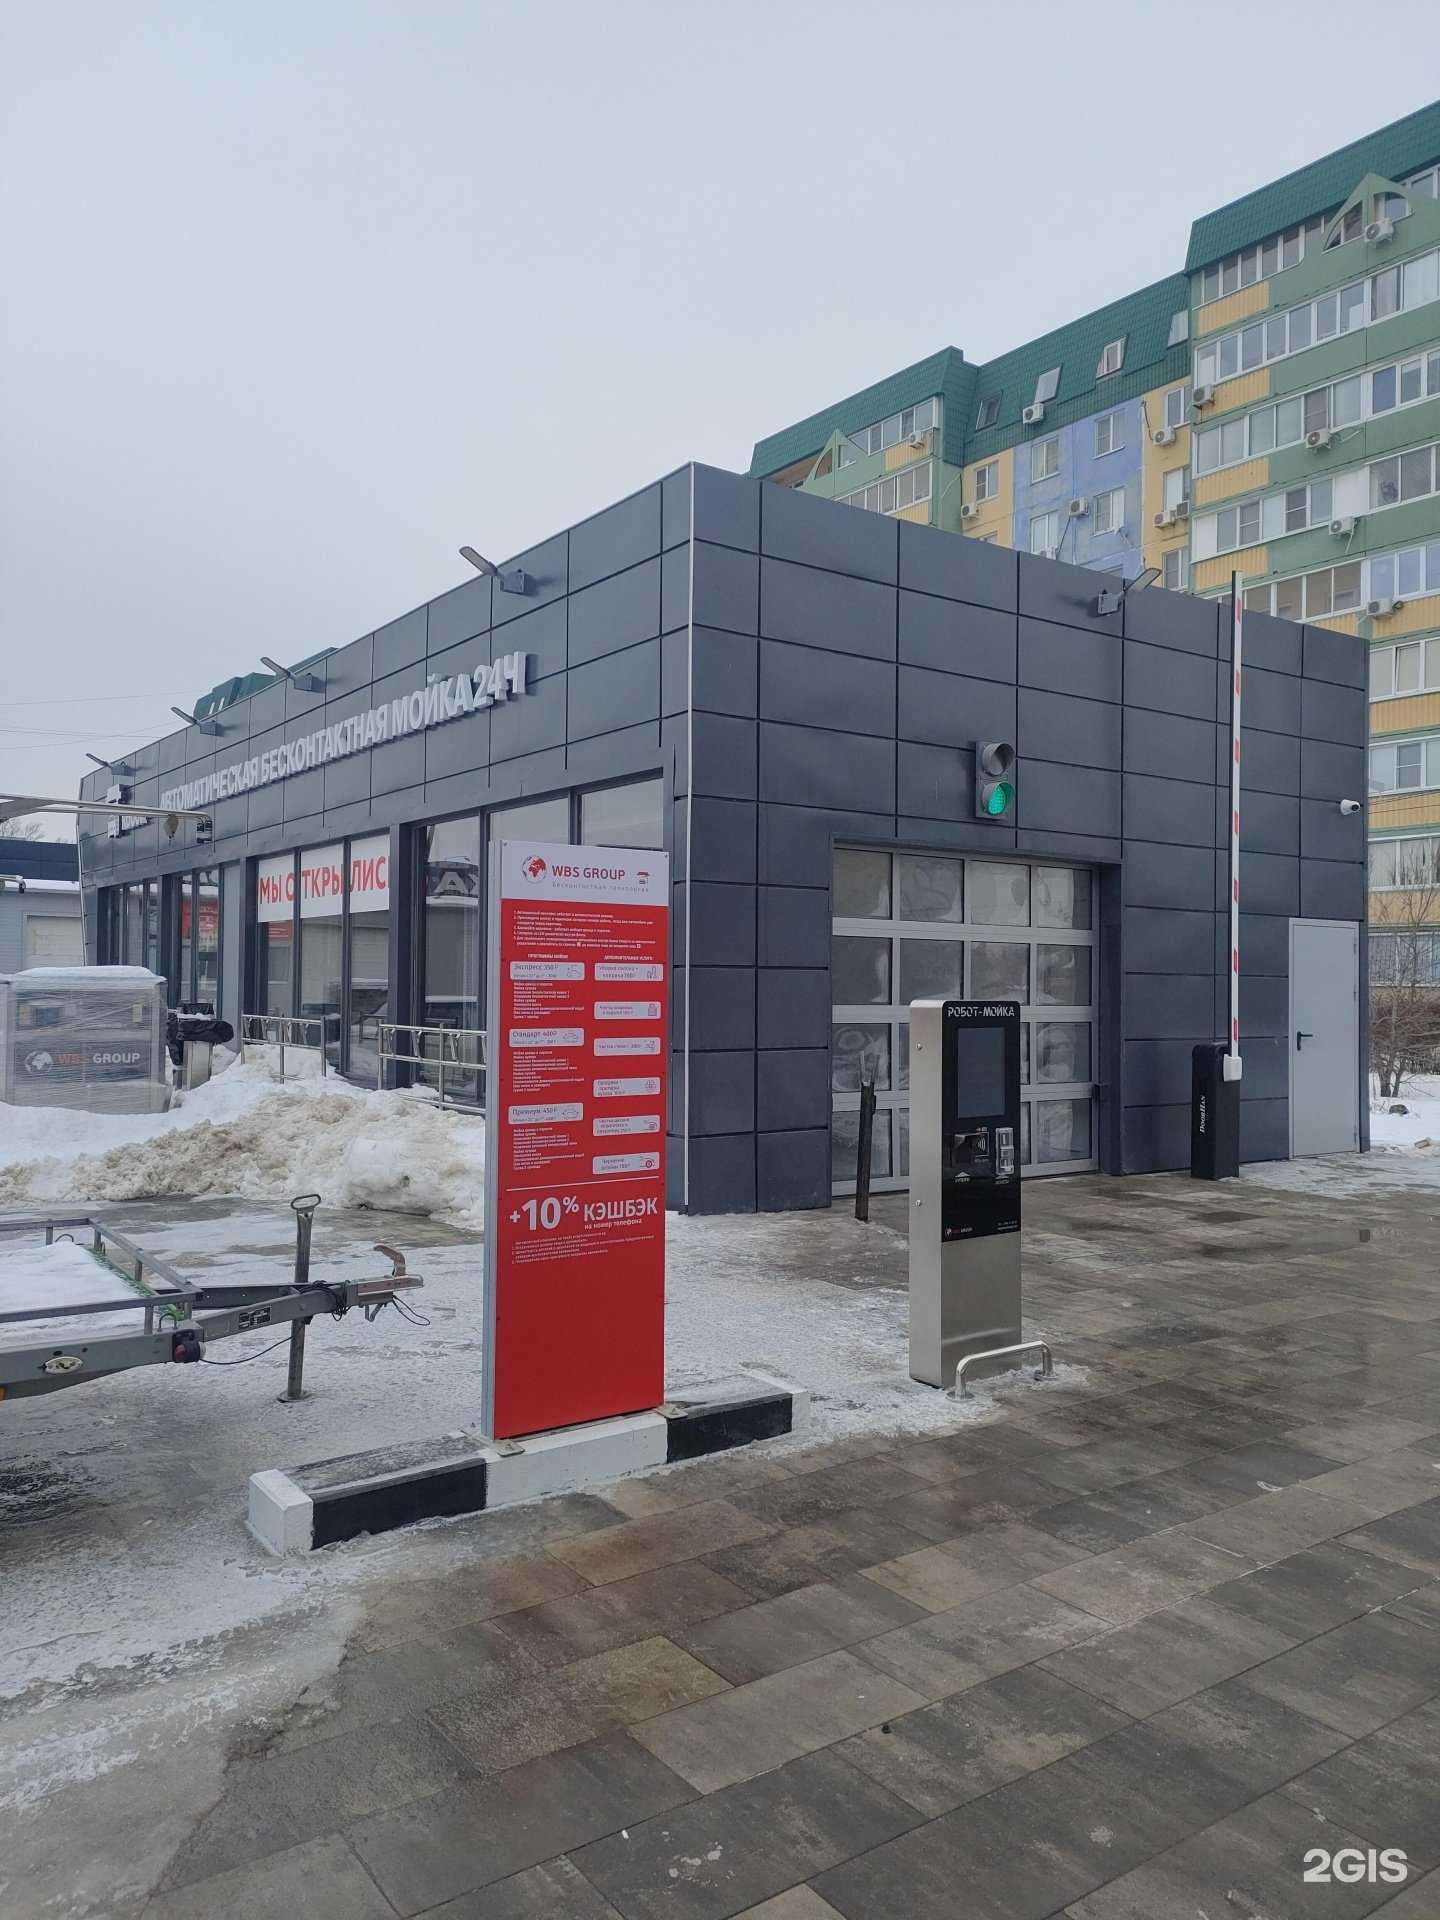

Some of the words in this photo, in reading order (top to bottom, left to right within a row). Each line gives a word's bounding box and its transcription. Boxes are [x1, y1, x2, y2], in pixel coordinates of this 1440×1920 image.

[261, 705, 389, 784] БЕСКОНТАКТНАЯ
[391, 673, 475, 738] МОЙКА
[552, 865, 580, 878] WBS
[583, 867, 626, 881] GROUP
[259, 876, 282, 905] МЫ
[947, 1005, 1015, 1018] РОБОТ-МОЙКА
[93, 1052, 141, 1064] GROUP
[584, 1197, 658, 1222] КЭШБЭК
